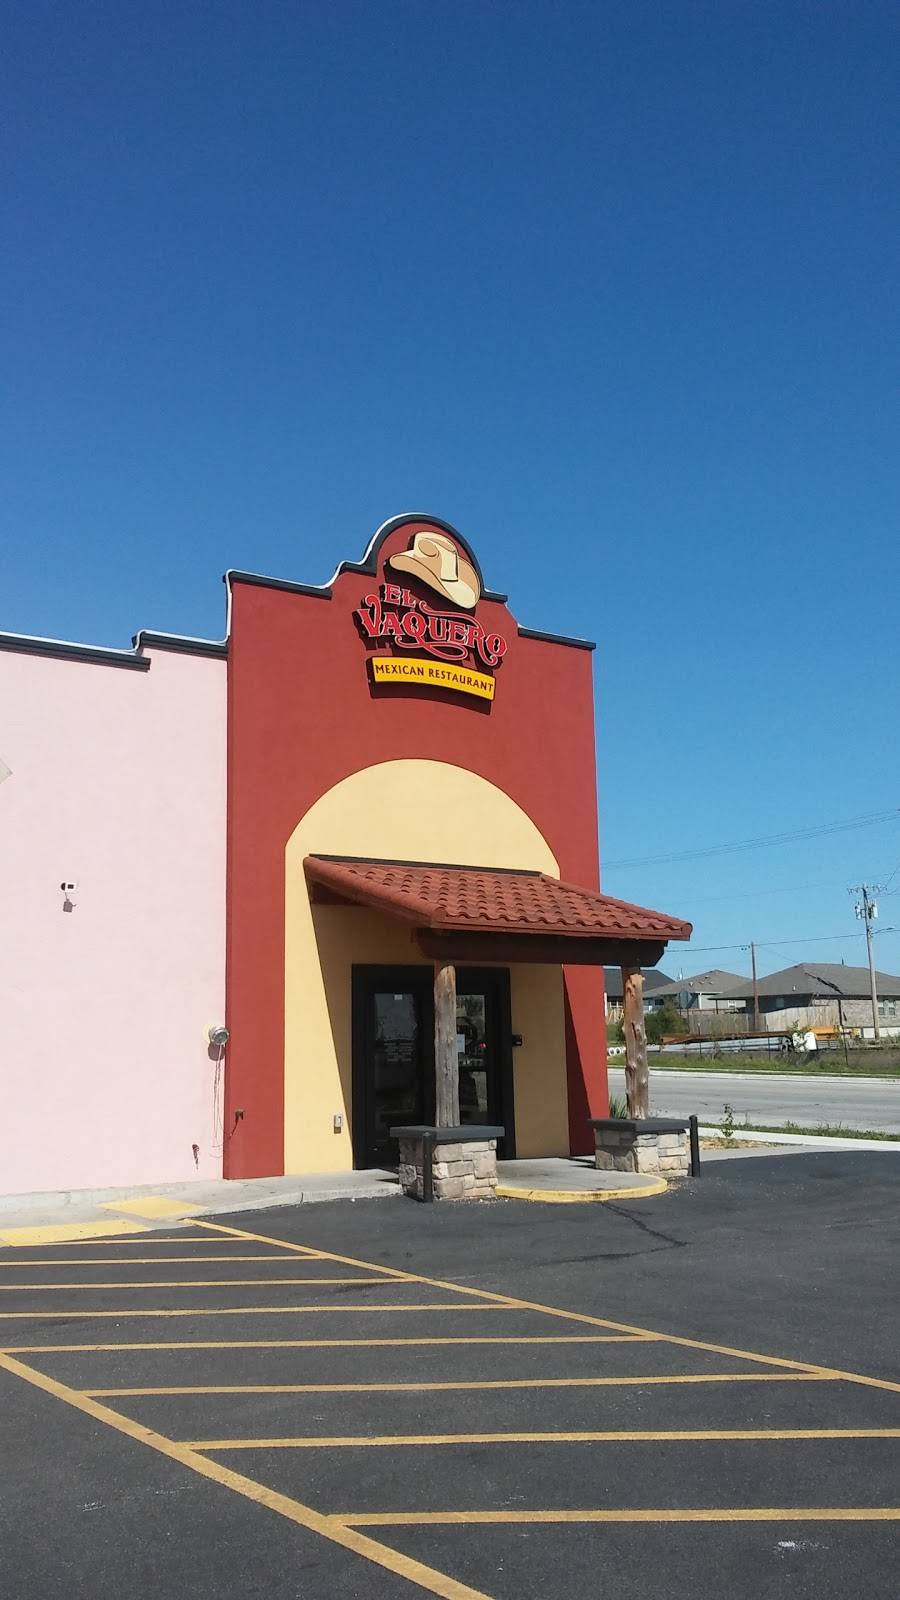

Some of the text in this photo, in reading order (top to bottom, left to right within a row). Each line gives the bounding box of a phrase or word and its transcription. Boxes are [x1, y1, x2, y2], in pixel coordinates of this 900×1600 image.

[384, 583, 417, 608] EL
[357, 594, 508, 666] VAQUERO
[375, 664, 494, 692] MEXICAN RESTAURANT
